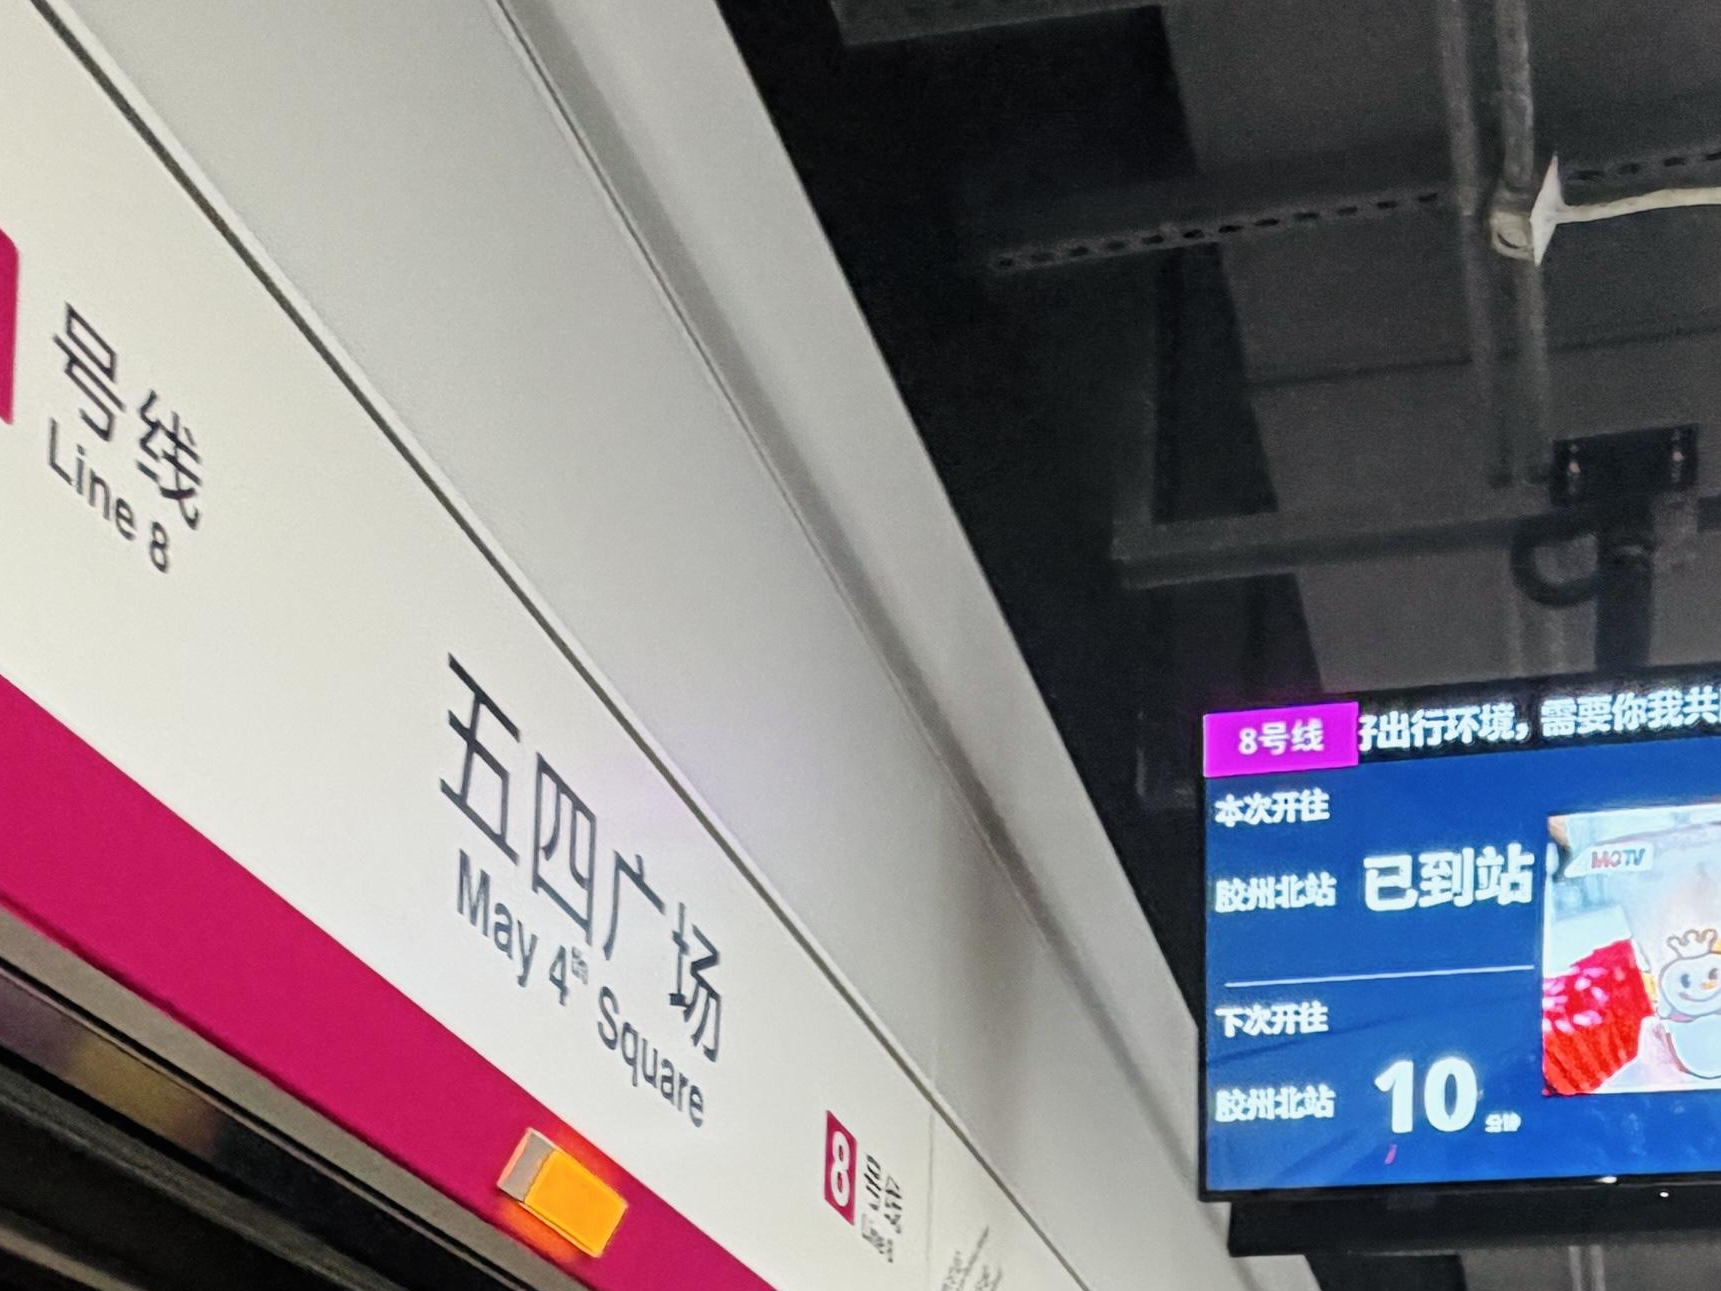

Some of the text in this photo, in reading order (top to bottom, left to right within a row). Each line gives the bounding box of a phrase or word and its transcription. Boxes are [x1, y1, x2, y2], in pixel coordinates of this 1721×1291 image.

[52, 301, 203, 531] 号线
[48, 417, 171, 574] Line 8
[1239, 718, 1324, 755] 8号线
[1215, 787, 1330, 828] 本次开往
[440, 652, 722, 1063] 五四广场
[1215, 842, 1535, 913] 胶州北站 已到站
[457, 849, 537, 988] May
[597, 985, 705, 1129] Square
[1215, 1000, 1330, 1038] 下次开往
[1215, 1083, 1336, 1122] 胶州北站
[1374, 1056, 1478, 1134] 10
[831, 1130, 851, 1208] 8
